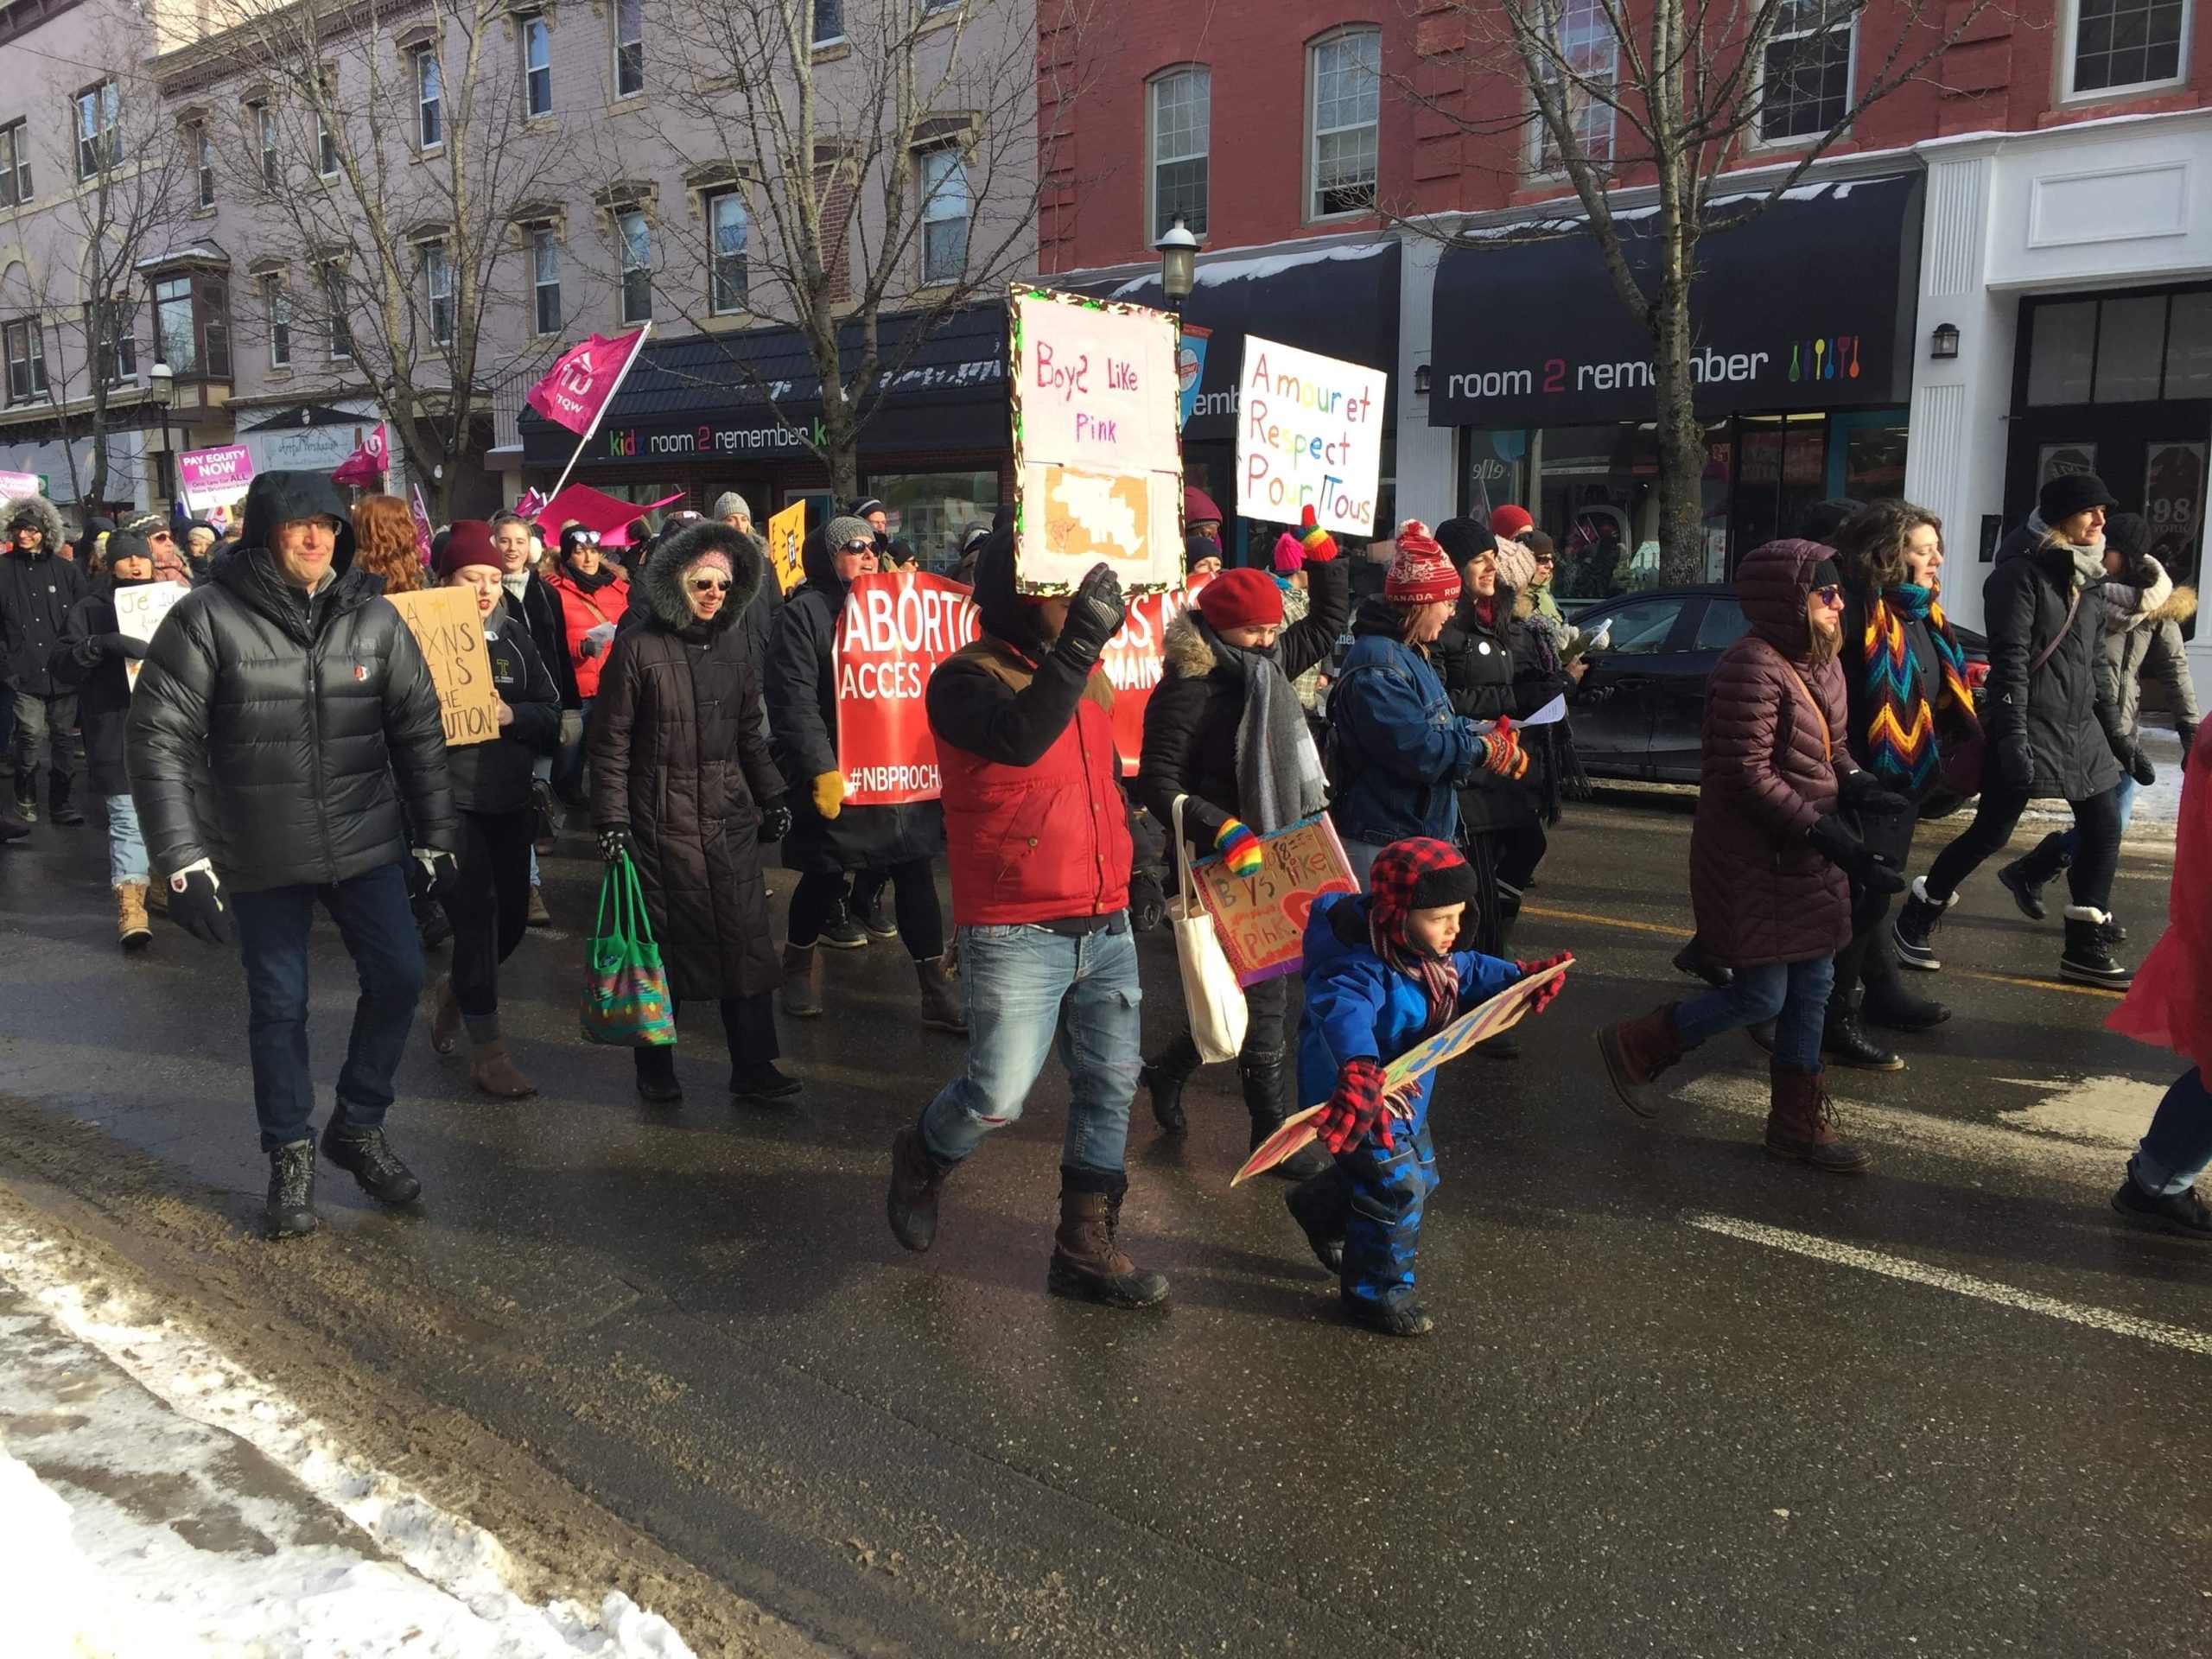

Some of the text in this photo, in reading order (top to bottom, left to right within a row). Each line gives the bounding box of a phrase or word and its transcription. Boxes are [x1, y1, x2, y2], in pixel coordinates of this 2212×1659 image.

[1037, 340, 1088, 401] Boys
[1449, 369, 1531, 398] room
[1543, 359, 1566, 392] 2
[1252, 353, 1370, 423] Amour et
[609, 429, 646, 456] kidz
[651, 433, 694, 453] room
[698, 426, 711, 450] 2
[715, 422, 808, 449] remember
[1076, 413, 1116, 444] Pink
[1250, 399, 1351, 471] Respect
[183, 450, 245, 467] PAY EQUITY
[198, 461, 236, 477] NOW
[231, 474, 248, 482] ALL
[1248, 453, 1313, 507] Pour
[2153, 499, 2190, 523] 98
[1389, 586, 1461, 601] CANADA ROO
[407, 602, 424, 629] A
[446, 657, 473, 685] IS
[497, 658, 509, 677] T
[1104, 657, 1165, 690] MAIN
[439, 689, 464, 709] HE
[444, 705, 493, 740] UTION
[849, 765, 943, 791] #NBPROCH
